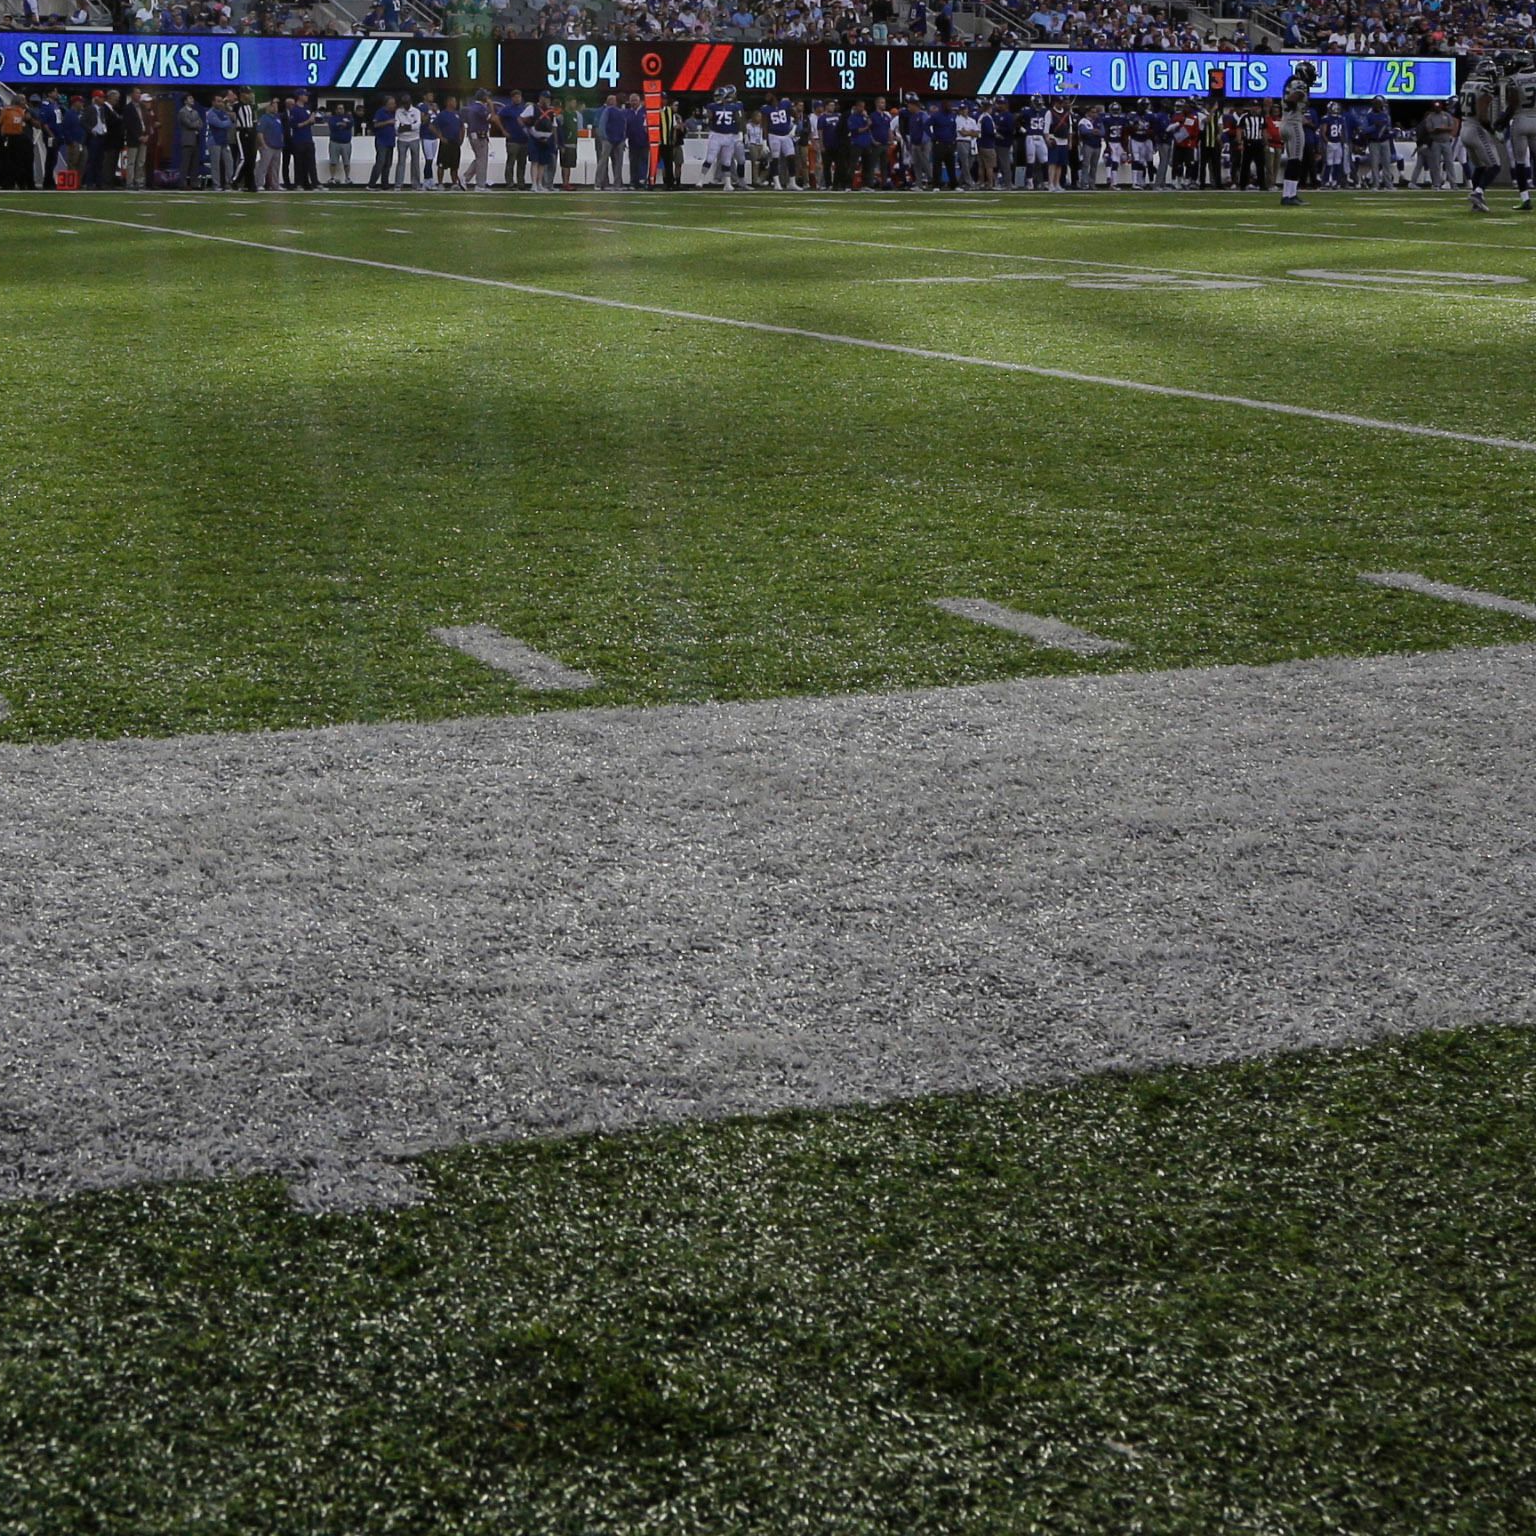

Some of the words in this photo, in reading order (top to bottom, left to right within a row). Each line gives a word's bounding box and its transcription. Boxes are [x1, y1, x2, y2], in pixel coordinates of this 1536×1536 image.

[18, 41, 200, 80] SEAHAWKS
[222, 42, 241, 80] 0
[300, 42, 327, 62] TOL
[405, 47, 450, 81] QTR
[467, 47, 479, 80] 1
[547, 44, 620, 88] 9:04
[743, 48, 784, 67] DOWN
[829, 49, 845, 67] TO
[850, 50, 867, 68] GO
[913, 51, 946, 69] BALL
[948, 52, 968, 70] ON
[1110, 57, 1127, 92] 0
[1147, 58, 1269, 92] GIANTS
[1385, 61, 1416, 93] 25
[307, 64, 319, 85] 3
[745, 68, 776, 89] 3RD
[839, 69, 856, 90] 13
[929, 71, 949, 91] 46
[1211, 71, 1224, 88] 3
[715, 110, 734, 125] 75
[58, 172, 76, 188] 30
